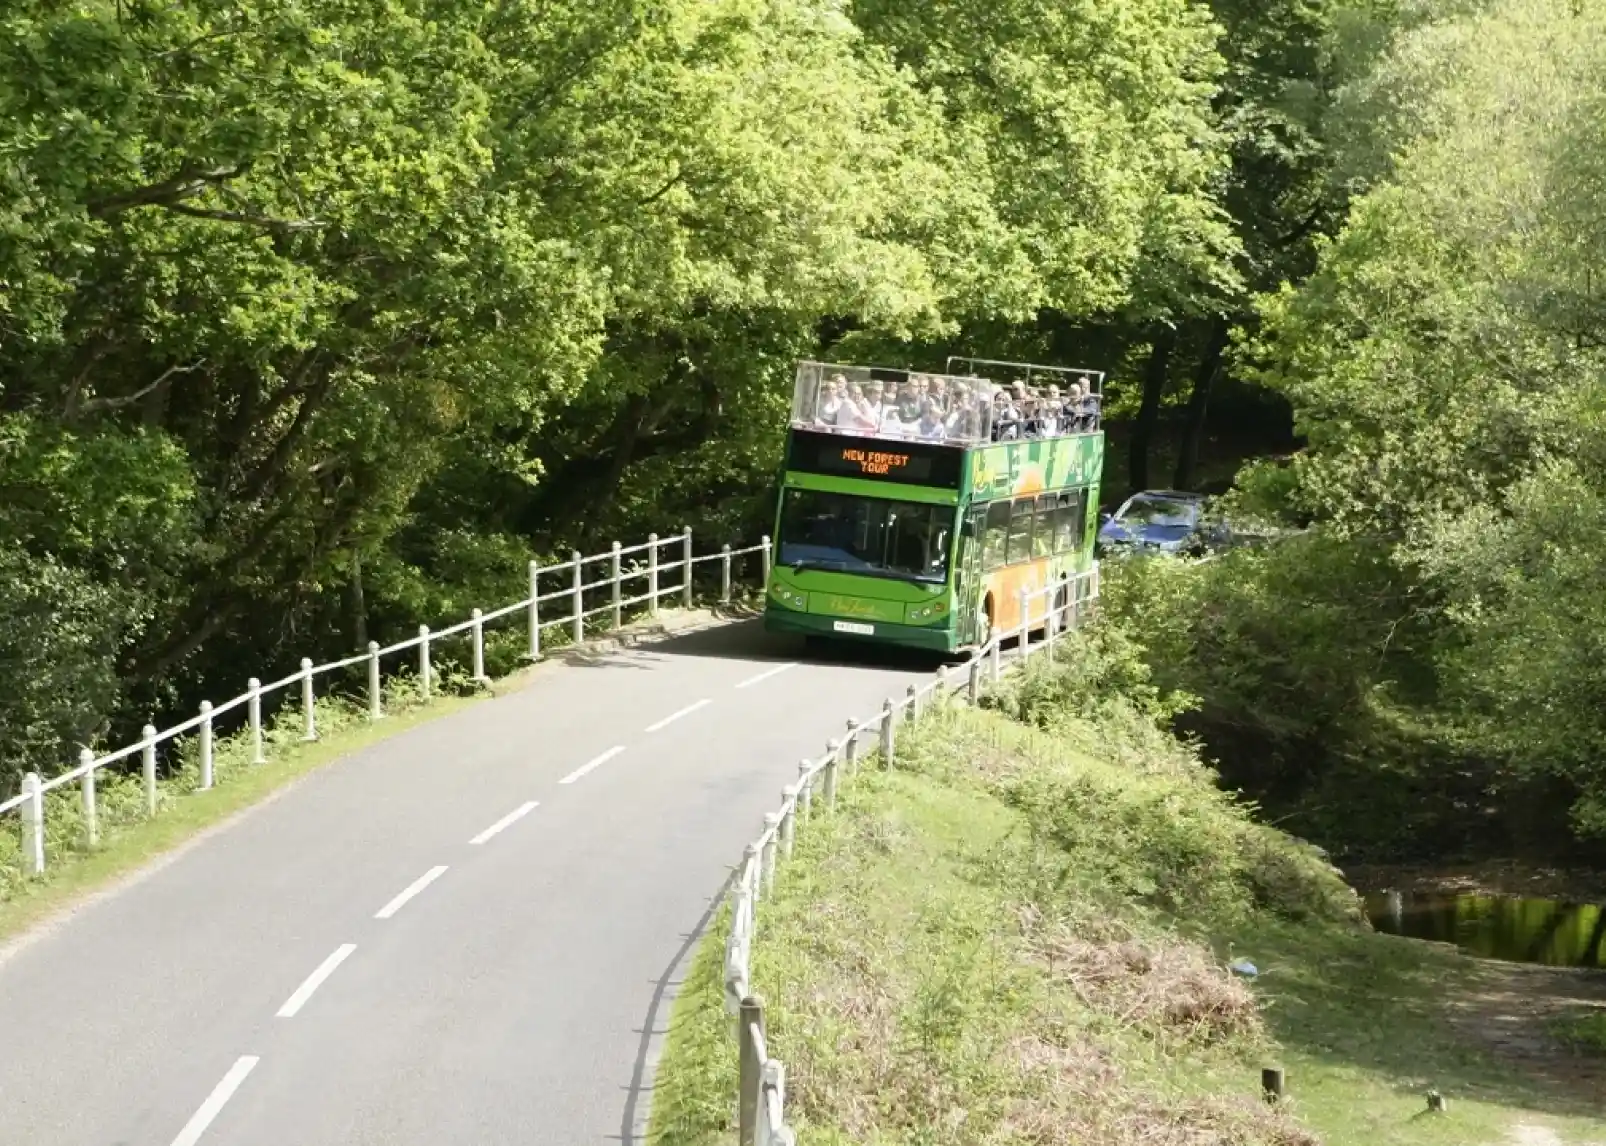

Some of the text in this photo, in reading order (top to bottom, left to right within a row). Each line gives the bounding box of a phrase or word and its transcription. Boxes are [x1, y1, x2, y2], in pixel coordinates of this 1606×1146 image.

[842, 449, 909, 466] NEW FOREST
[861, 461, 888, 474] TOUR
